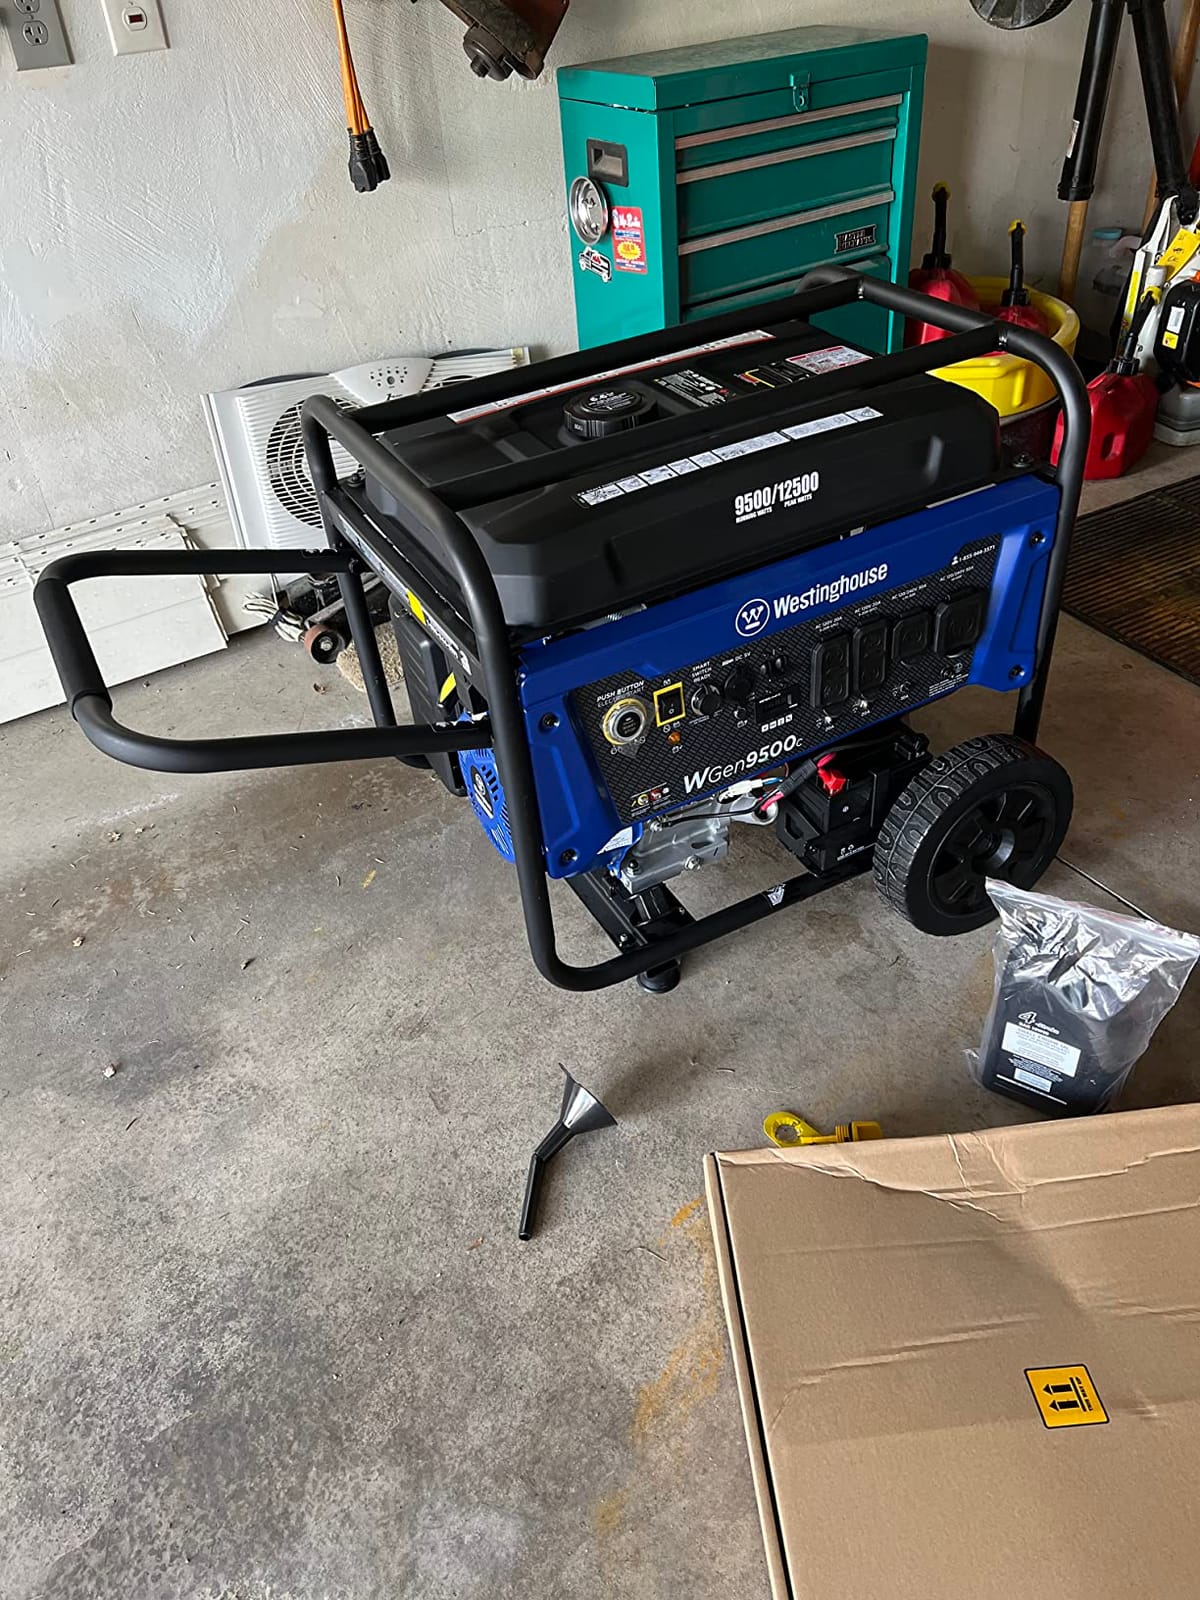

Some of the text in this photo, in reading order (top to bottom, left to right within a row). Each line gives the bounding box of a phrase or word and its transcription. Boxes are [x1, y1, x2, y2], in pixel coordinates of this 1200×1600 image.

[734, 471, 819, 516] 9500/12500
[773, 563, 889, 620] Westinghouse
[691, 667, 712, 679] SWITCH
[692, 661, 711, 672] SMART
[596, 680, 645, 703] PUSH BUTTON
